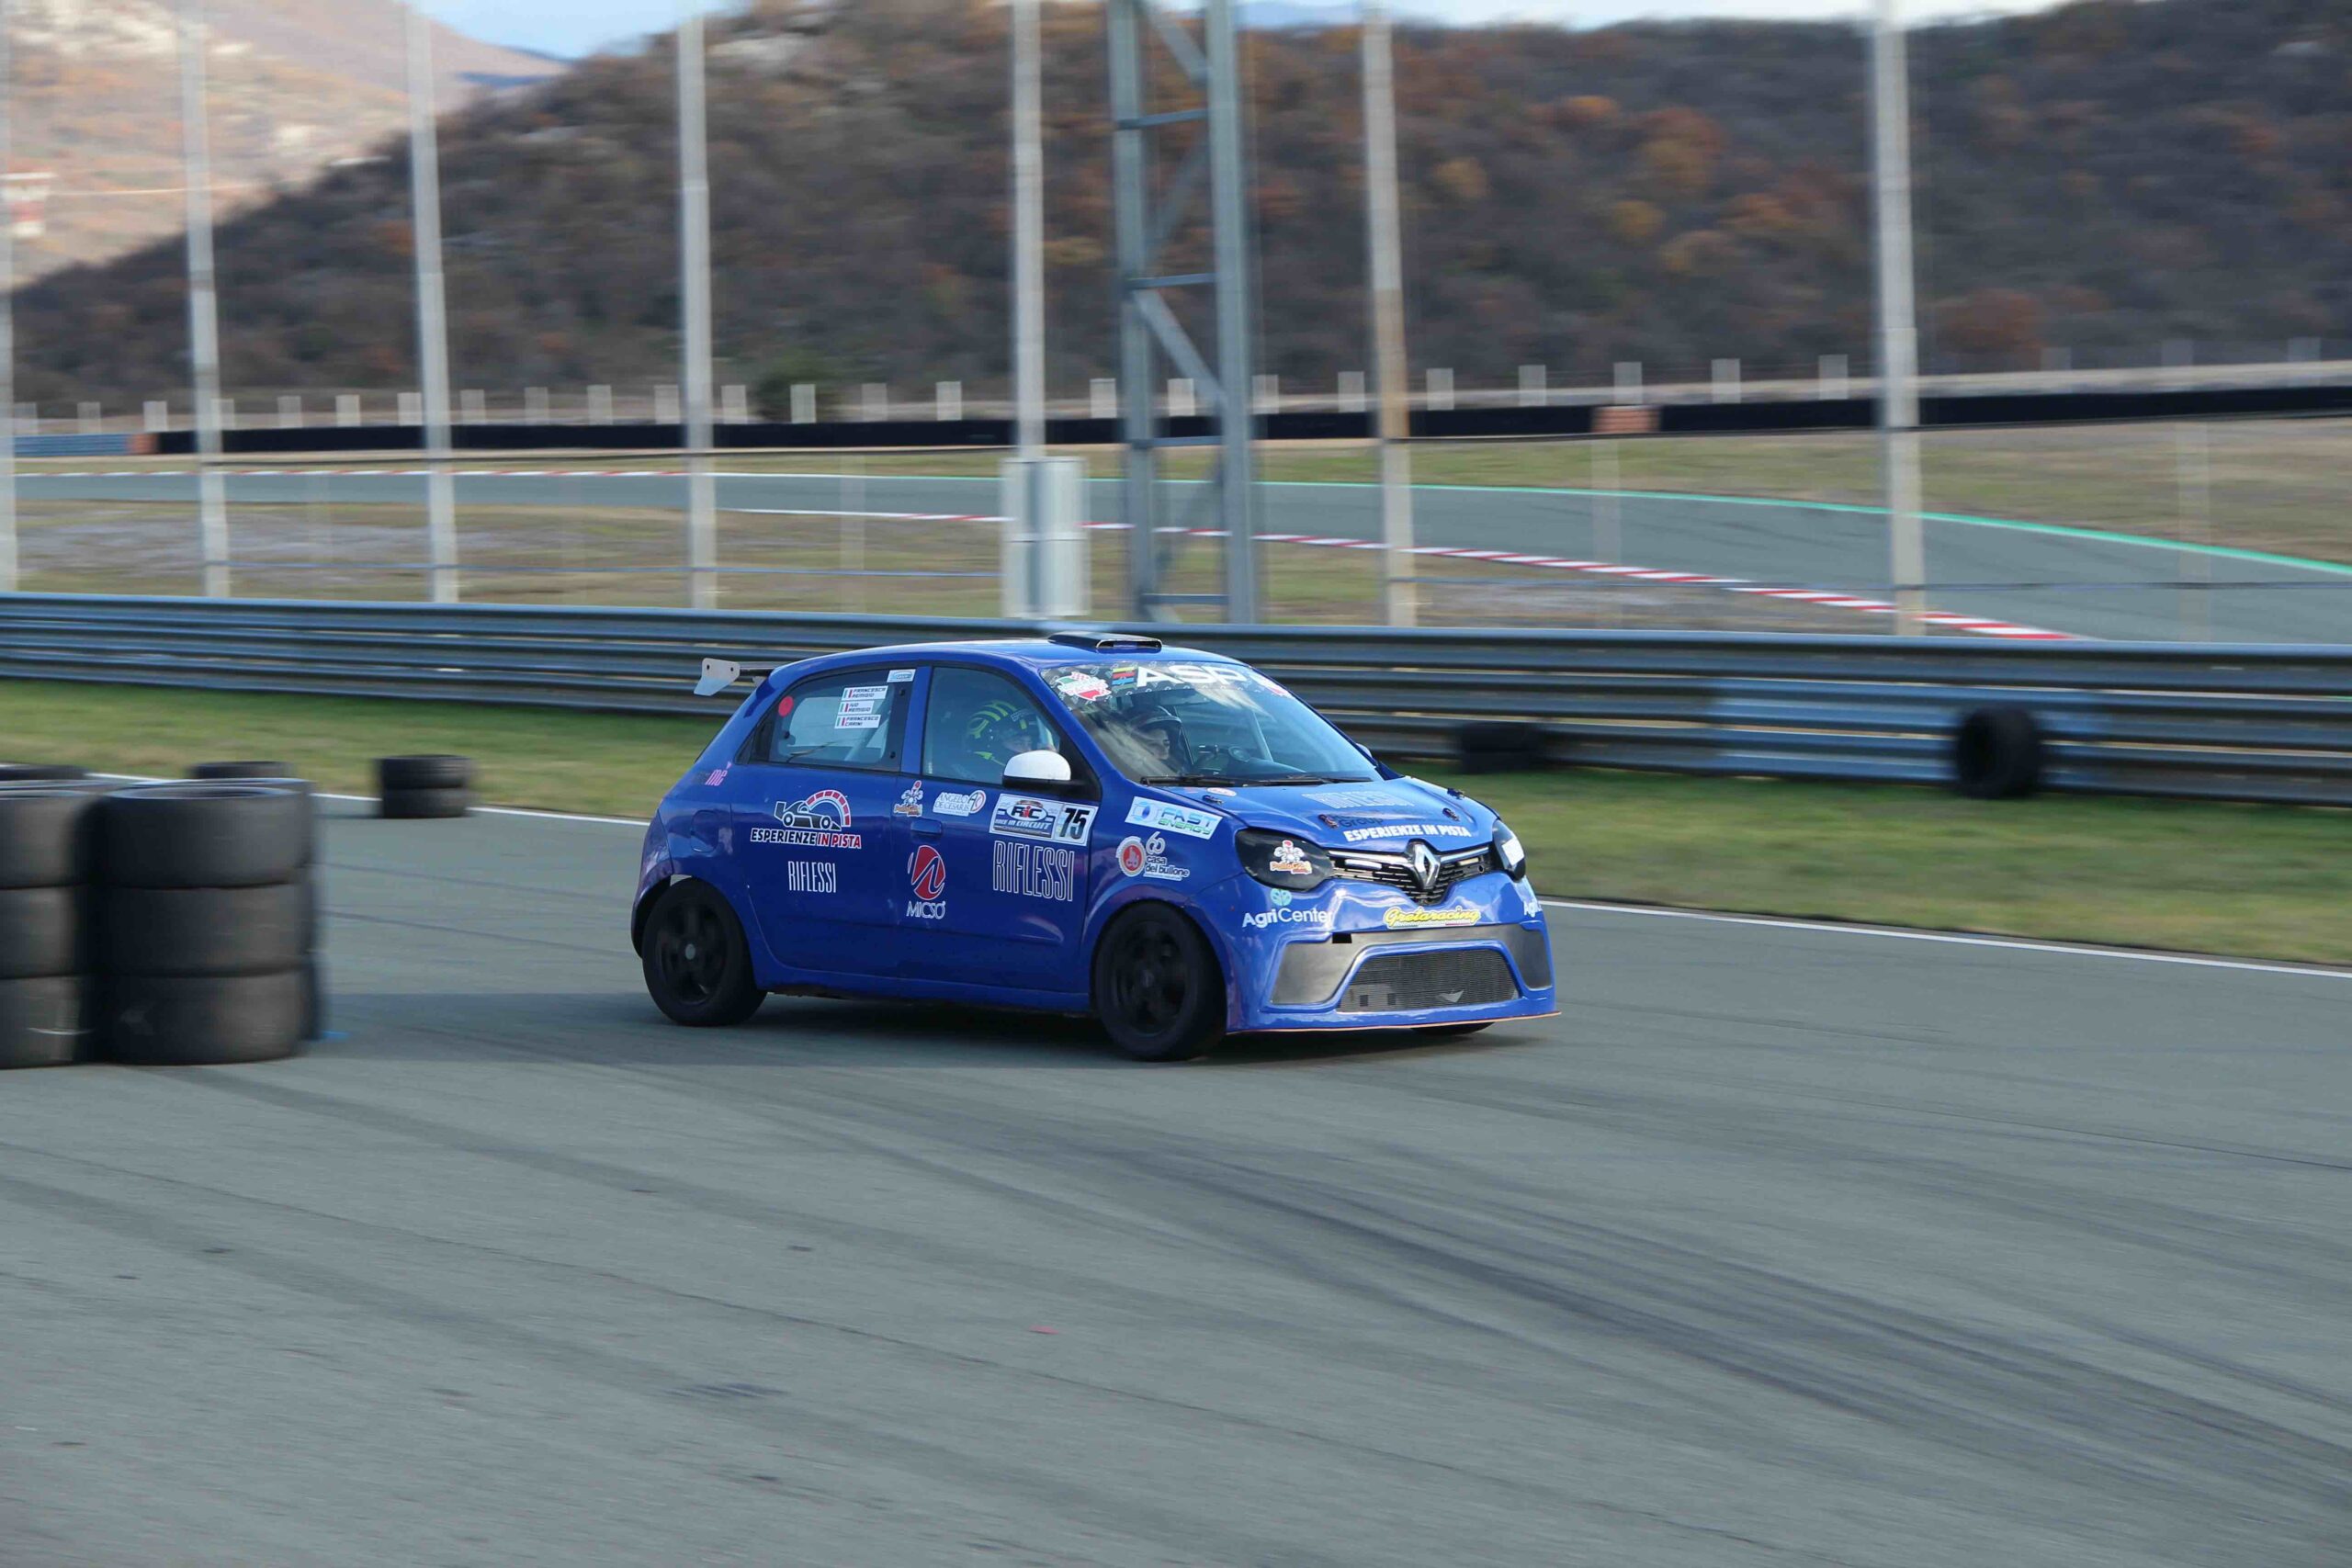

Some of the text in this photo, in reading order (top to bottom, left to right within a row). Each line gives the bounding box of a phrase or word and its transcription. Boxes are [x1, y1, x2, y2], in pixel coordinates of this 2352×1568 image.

[1136, 665, 1247, 687] ASP
[1016, 820, 1052, 829] CIRCUIT
[1059, 807, 1090, 840] 75
[1160, 807, 1218, 828] FAST
[751, 828, 862, 850] ESPERIENZE IN PISTA
[1343, 825, 1472, 842] ESPERIENZE IN PISTA
[1146, 864, 1158, 873] del
[1159, 865, 1190, 876] bullone
[1147, 856, 1167, 864] casa
[787, 861, 837, 894] RIFLESSI
[993, 840, 1075, 902] RIFLESSI
[1385, 908, 1479, 927] Gretaracing
